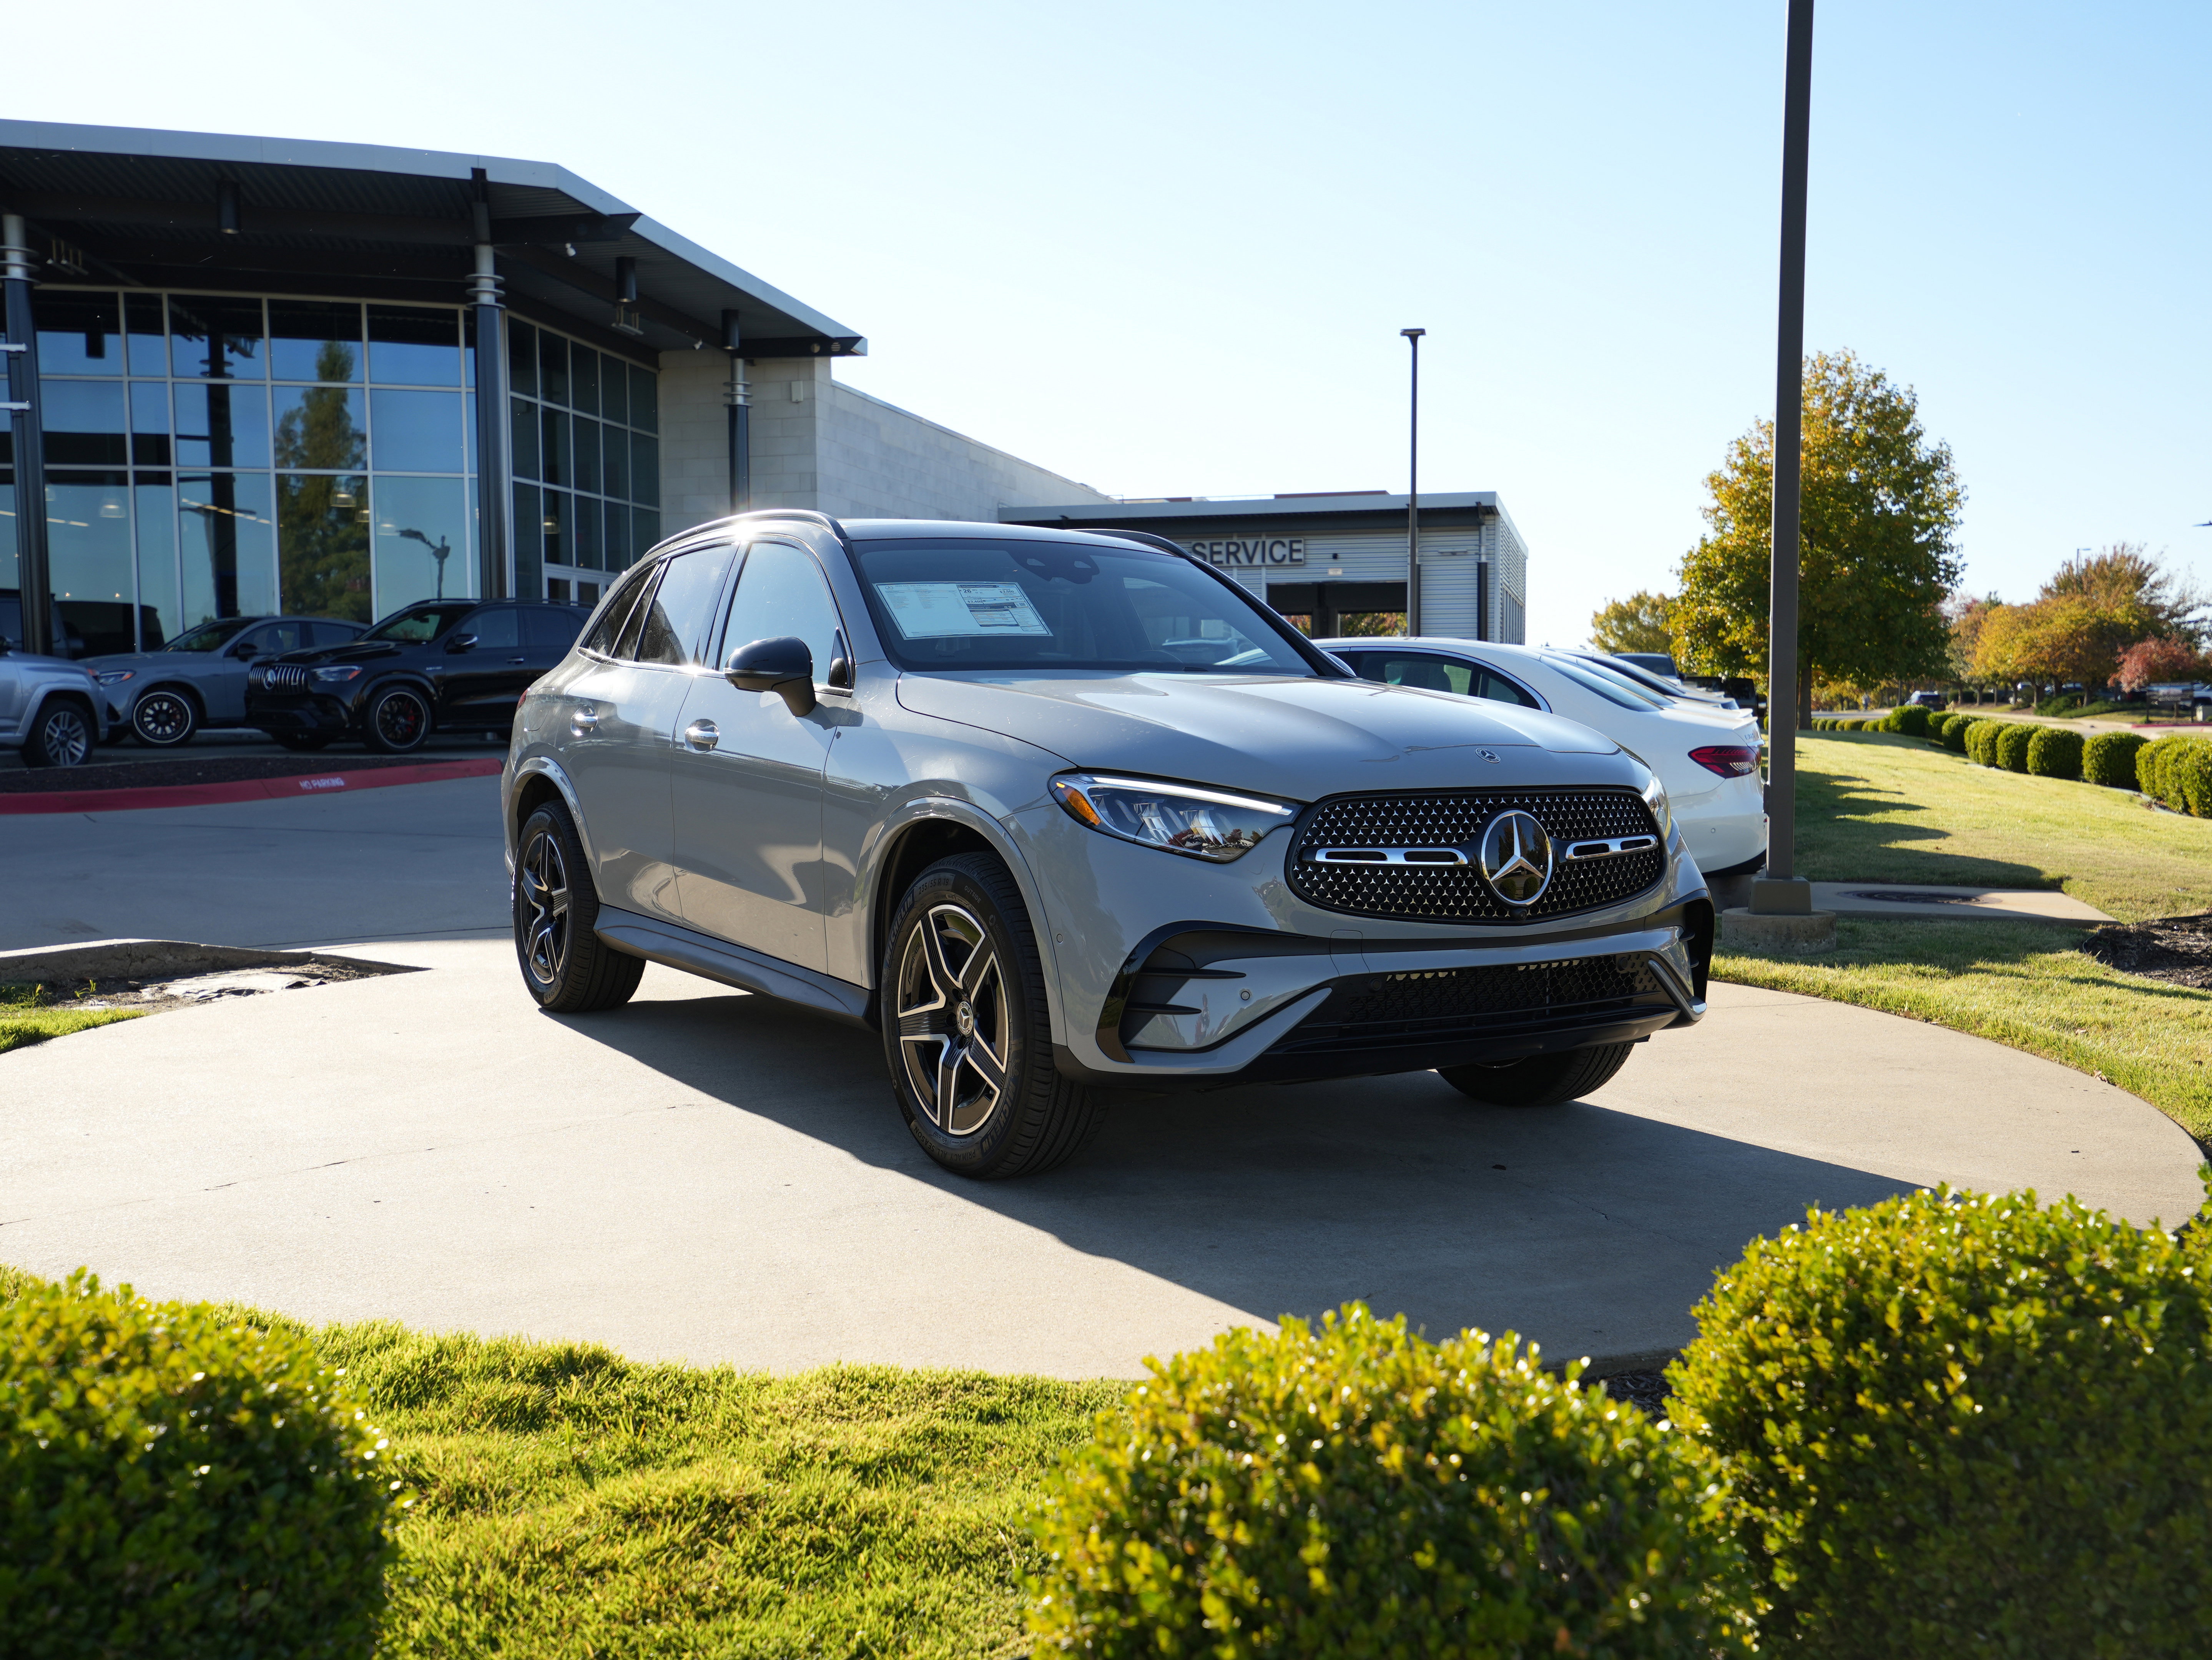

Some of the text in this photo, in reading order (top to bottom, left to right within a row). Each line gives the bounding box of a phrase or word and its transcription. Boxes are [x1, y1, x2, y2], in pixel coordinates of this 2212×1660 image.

[1192, 540, 1303, 564] SERVICE
[299, 777, 345, 790] NO PARKING
[919, 879, 936, 895] 235/55
[964, 885, 982, 904] OUTSIDE
[886, 893, 914, 965] MICHELIN
[550, 981, 560, 996] 255/50
[982, 1079, 1016, 1153] MICHELIN
[914, 1126, 935, 1152] SEASON
[937, 1148, 947, 1159] ALL
[950, 1149, 976, 1161] PRIMACY
